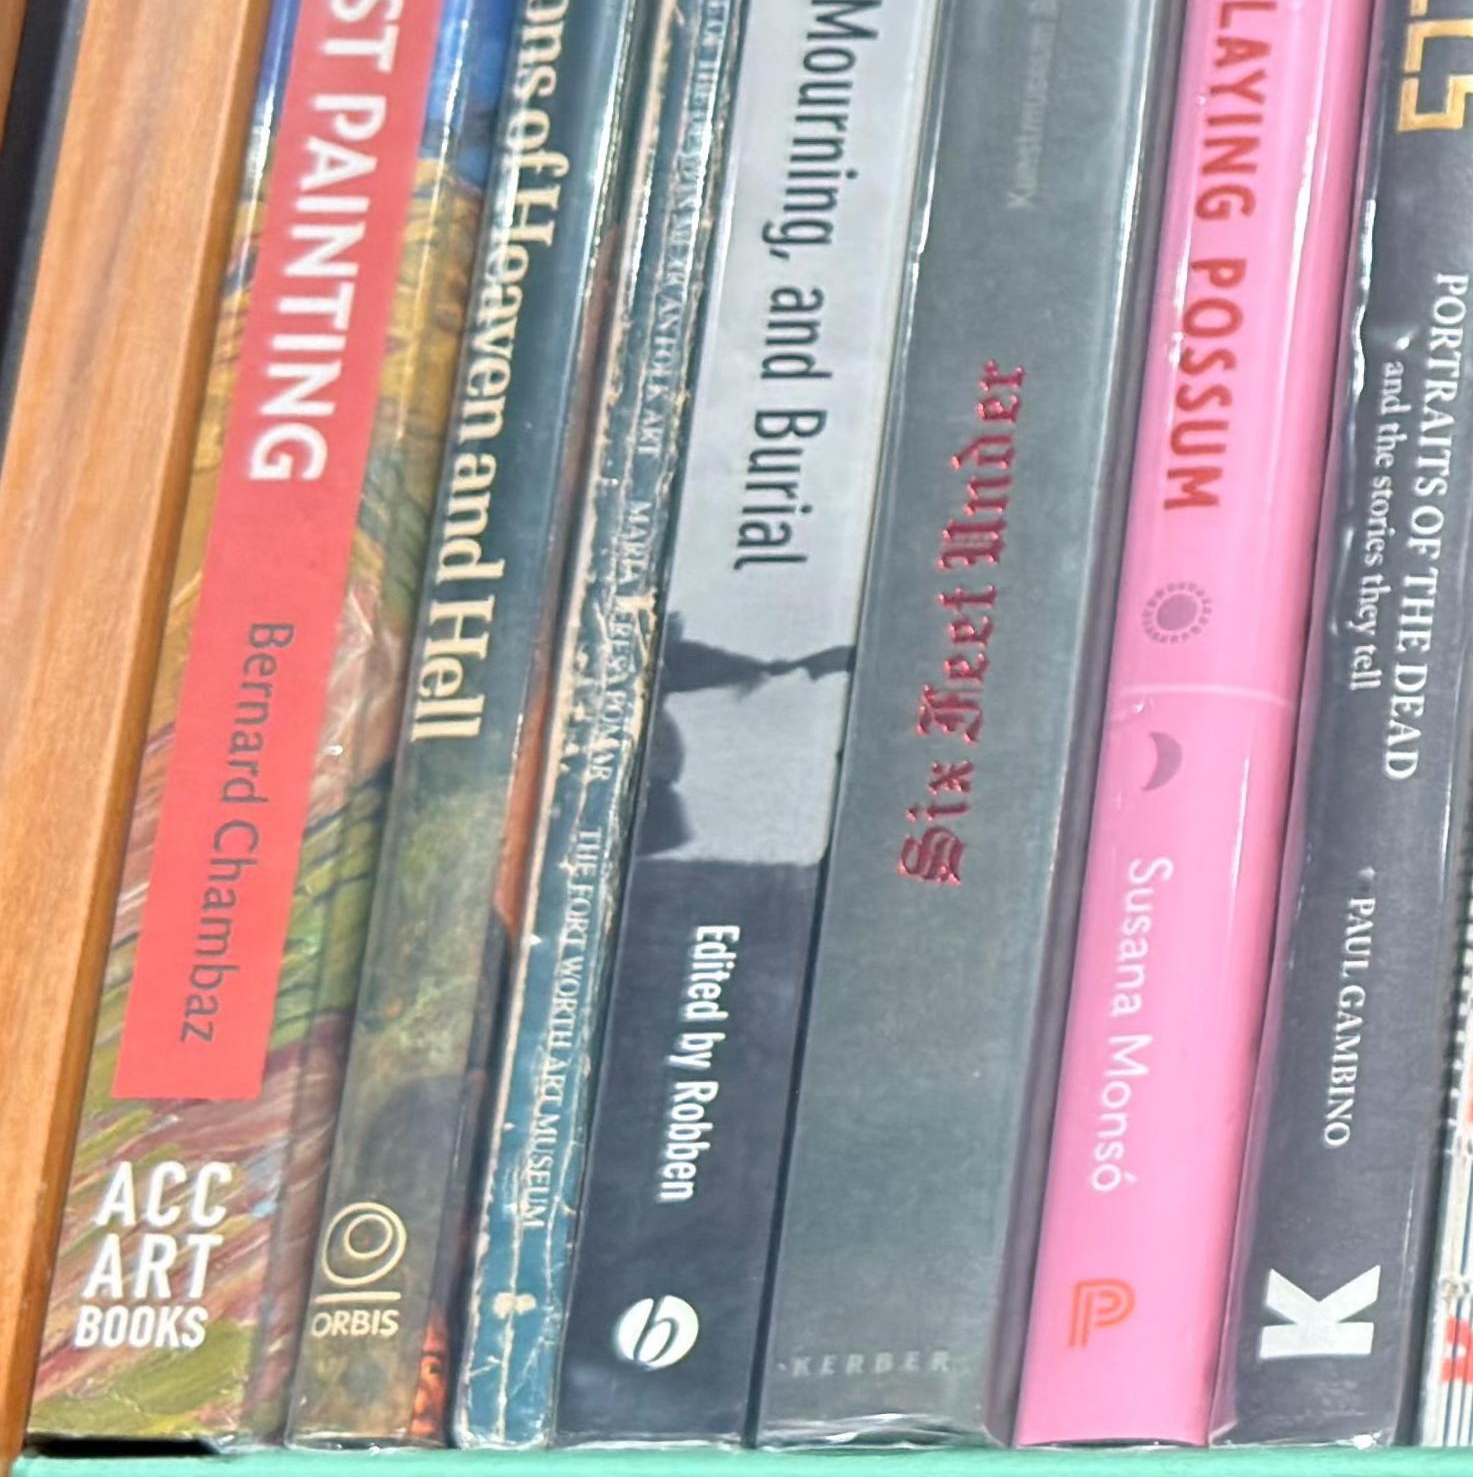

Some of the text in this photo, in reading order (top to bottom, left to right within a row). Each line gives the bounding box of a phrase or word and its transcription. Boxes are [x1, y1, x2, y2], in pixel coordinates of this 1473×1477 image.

[505, 111, 570, 179] of
[246, 94, 388, 481] PAINTING
[458, 183, 561, 444] Heaven
[760, 287, 833, 380] and
[637, 412, 665, 459] ART
[1161, 258, 1248, 514] POSSUM
[435, 453, 504, 584] and
[618, 500, 653, 586] MARIA
[732, 410, 828, 570] Burial
[1347, 360, 1412, 692] and the stories they tell
[1382, 273, 1469, 781] PORTRAITS OF THE DEAD
[409, 595, 495, 741] Hell
[896, 358, 1026, 886] Six Feet Under
[180, 622, 295, 1043] Bernard Chambaz
[521, 829, 602, 1228] THE FORT WORTH ART MUSEUM
[654, 925, 740, 1204] Edited by Robben
[1090, 855, 1174, 1193] Susana Monsó
[1323, 895, 1377, 1150] PAUL GAMBINO
[82, 1233, 224, 1299] ART
[94, 1161, 233, 1227] ACC
[74, 1305, 210, 1349] BOOKS
[311, 1309, 401, 1338] ORBIS
[792, 1349, 955, 1378] KERBER
[1258, 1264, 1382, 1359] K
